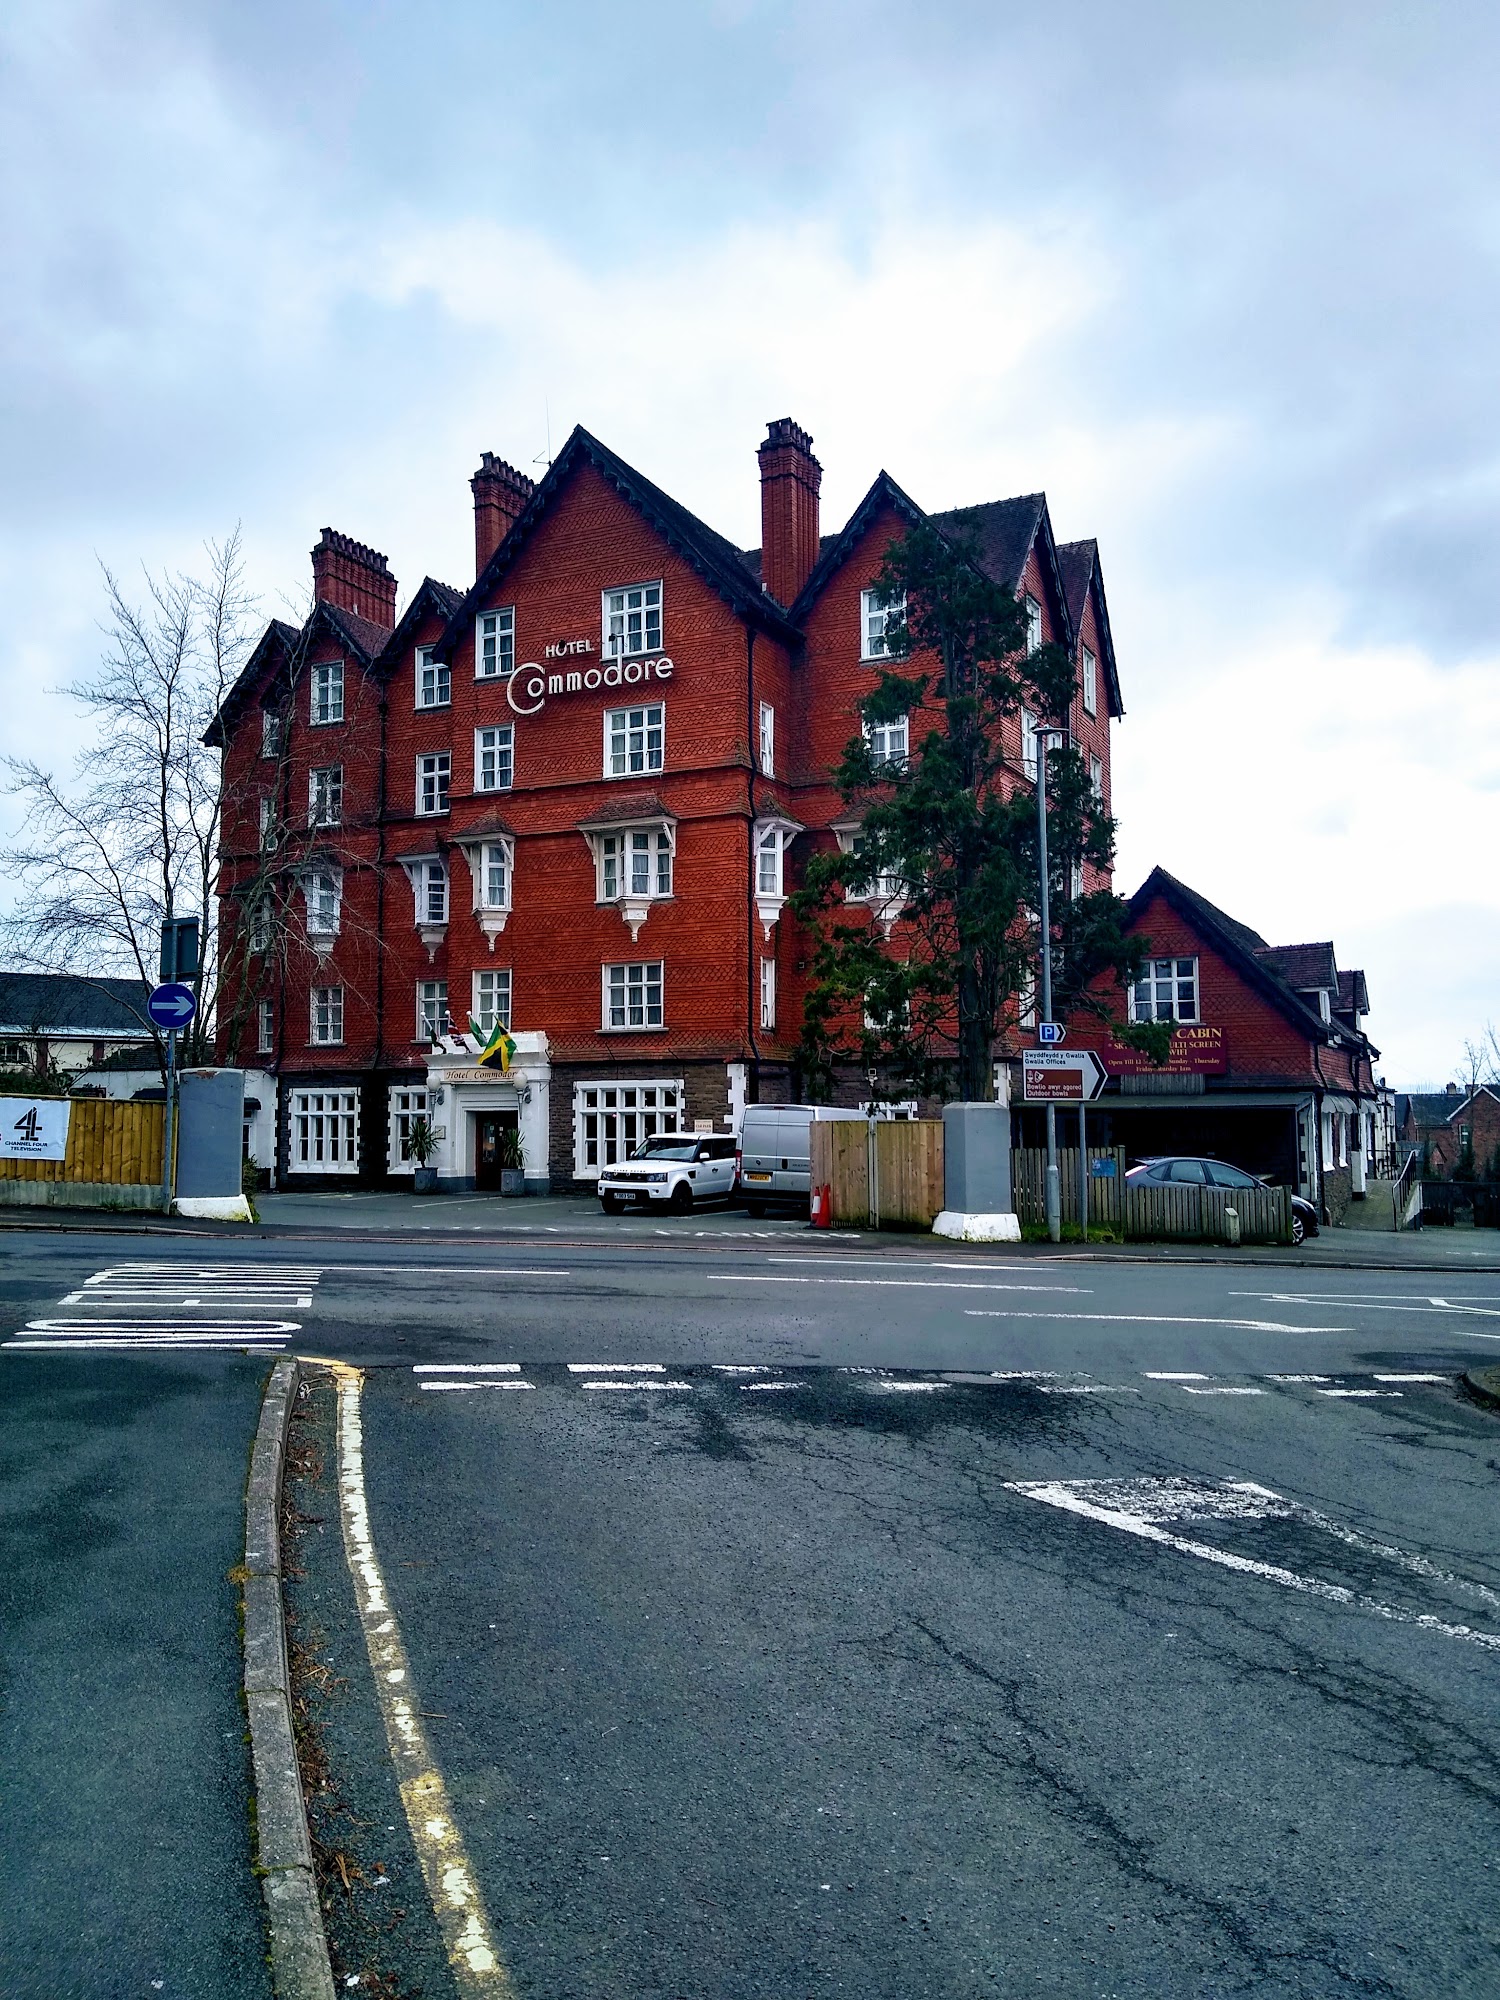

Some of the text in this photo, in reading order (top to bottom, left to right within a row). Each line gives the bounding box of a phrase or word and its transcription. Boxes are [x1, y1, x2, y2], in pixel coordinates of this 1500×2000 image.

[545, 639, 595, 659] HOTEL
[507, 636, 674, 715] Commodore
[1044, 1026, 1053, 1038] P
[1176, 1028, 1222, 1039] CABIN
[1169, 1041, 1187, 1049] ULTI
[446, 1070, 517, 1080] Hotel Commodor
[14, 1106, 42, 1141] 4
